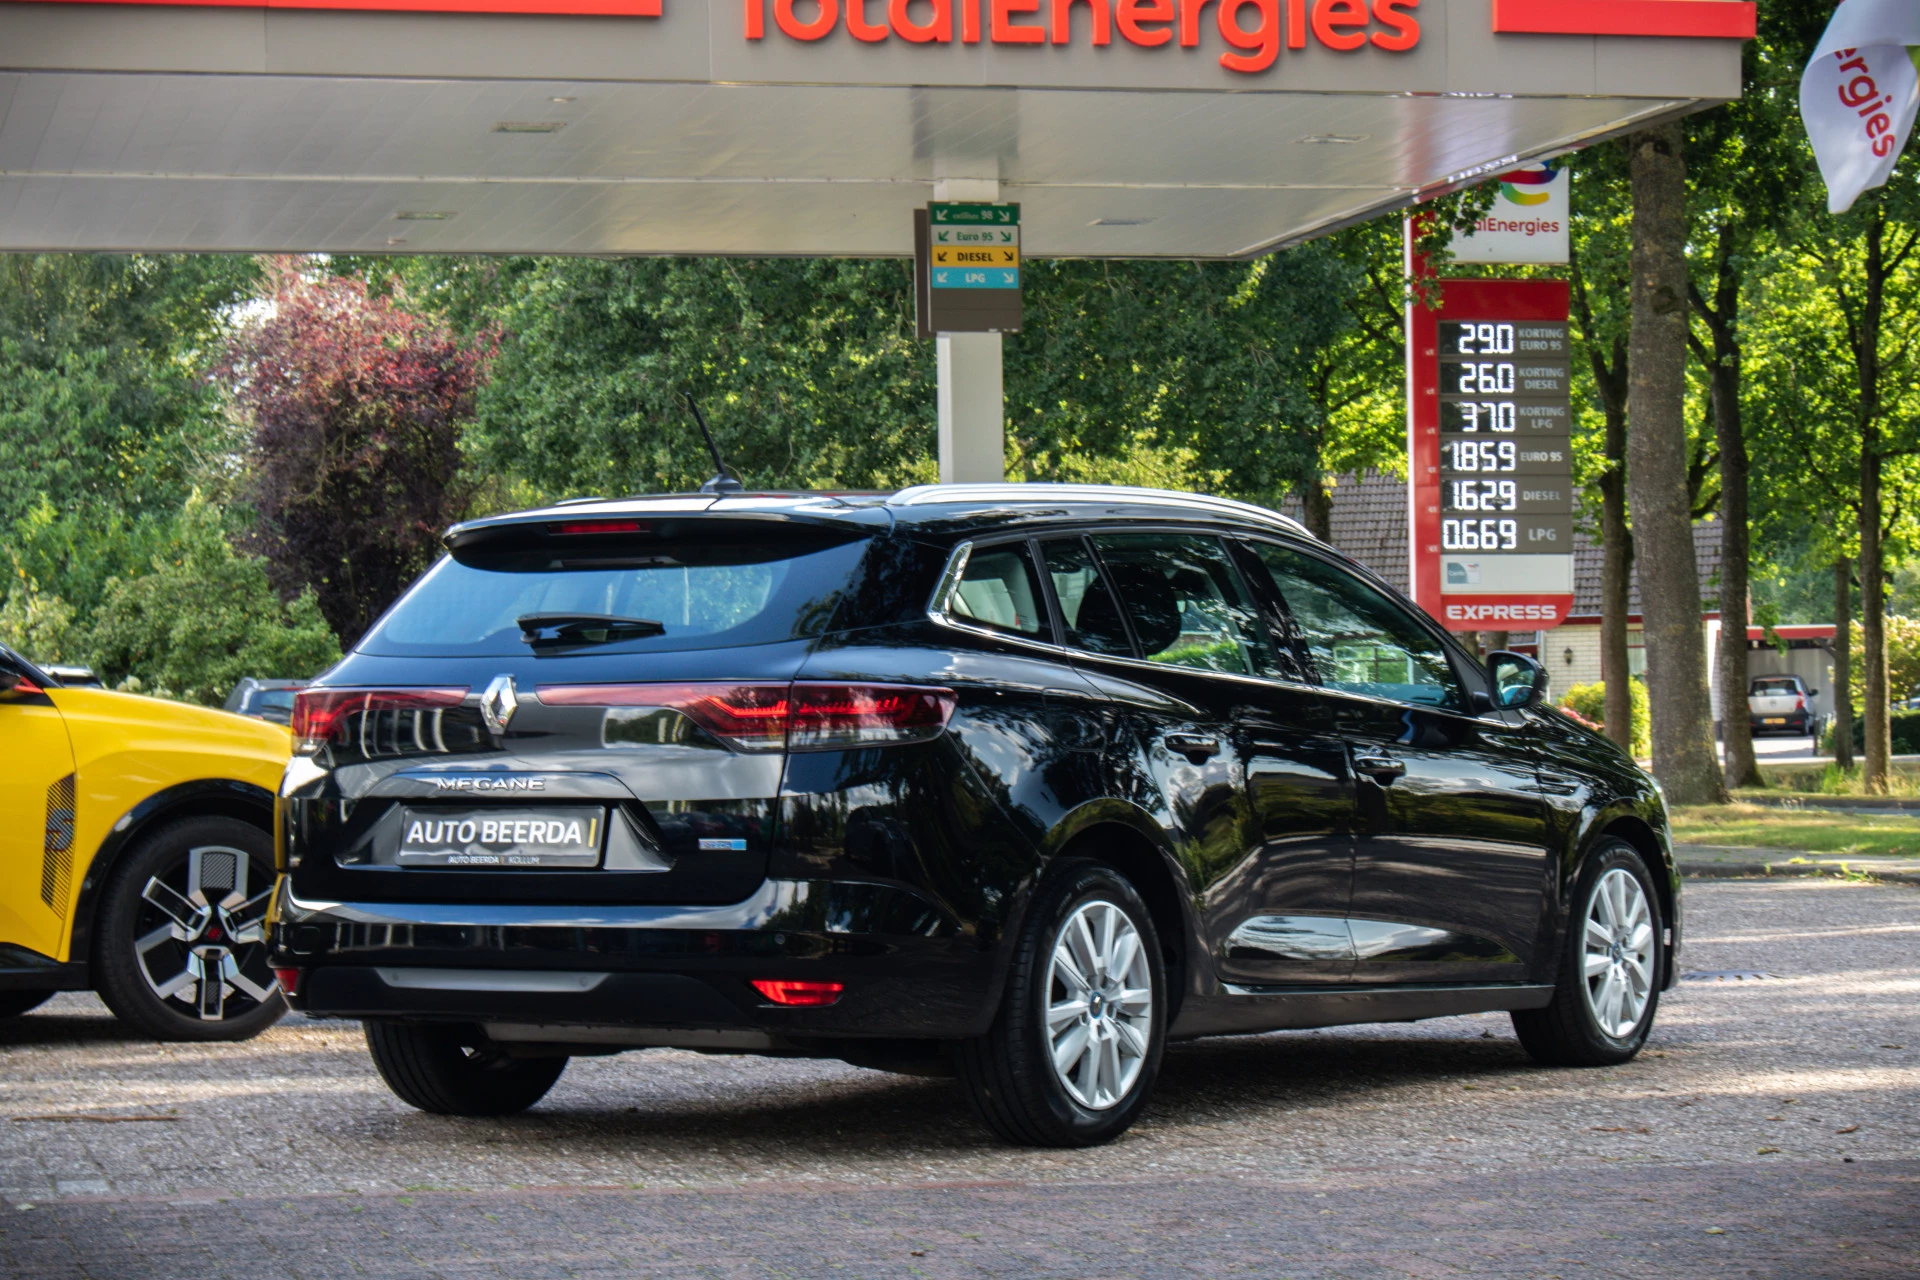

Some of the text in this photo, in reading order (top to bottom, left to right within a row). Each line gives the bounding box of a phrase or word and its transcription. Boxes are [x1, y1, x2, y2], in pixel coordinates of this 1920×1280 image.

[1834, 48, 1896, 158] rgies
[956, 231, 994, 241] Euro 95
[957, 252, 993, 262] DIESEL
[965, 273, 985, 283] LPG
[1518, 328, 1564, 339] KORTING
[1520, 341, 1562, 350] EURO 95
[1519, 368, 1564, 377] KORTING
[1524, 380, 1559, 390] DIESEL
[1520, 407, 1565, 416] KORTING
[1531, 419, 1553, 429] LPG
[1520, 451, 1562, 461] EURO 95
[1523, 491, 1560, 501] DIESEL
[1528, 528, 1557, 541] LPG
[1446, 605, 1557, 620] EXPRESS
[436, 777, 546, 791] MEGANE
[406, 821, 582, 844] AUTO BEERDA
[449, 856, 468, 864] AUTO
[470, 856, 499, 864] BEERDA
